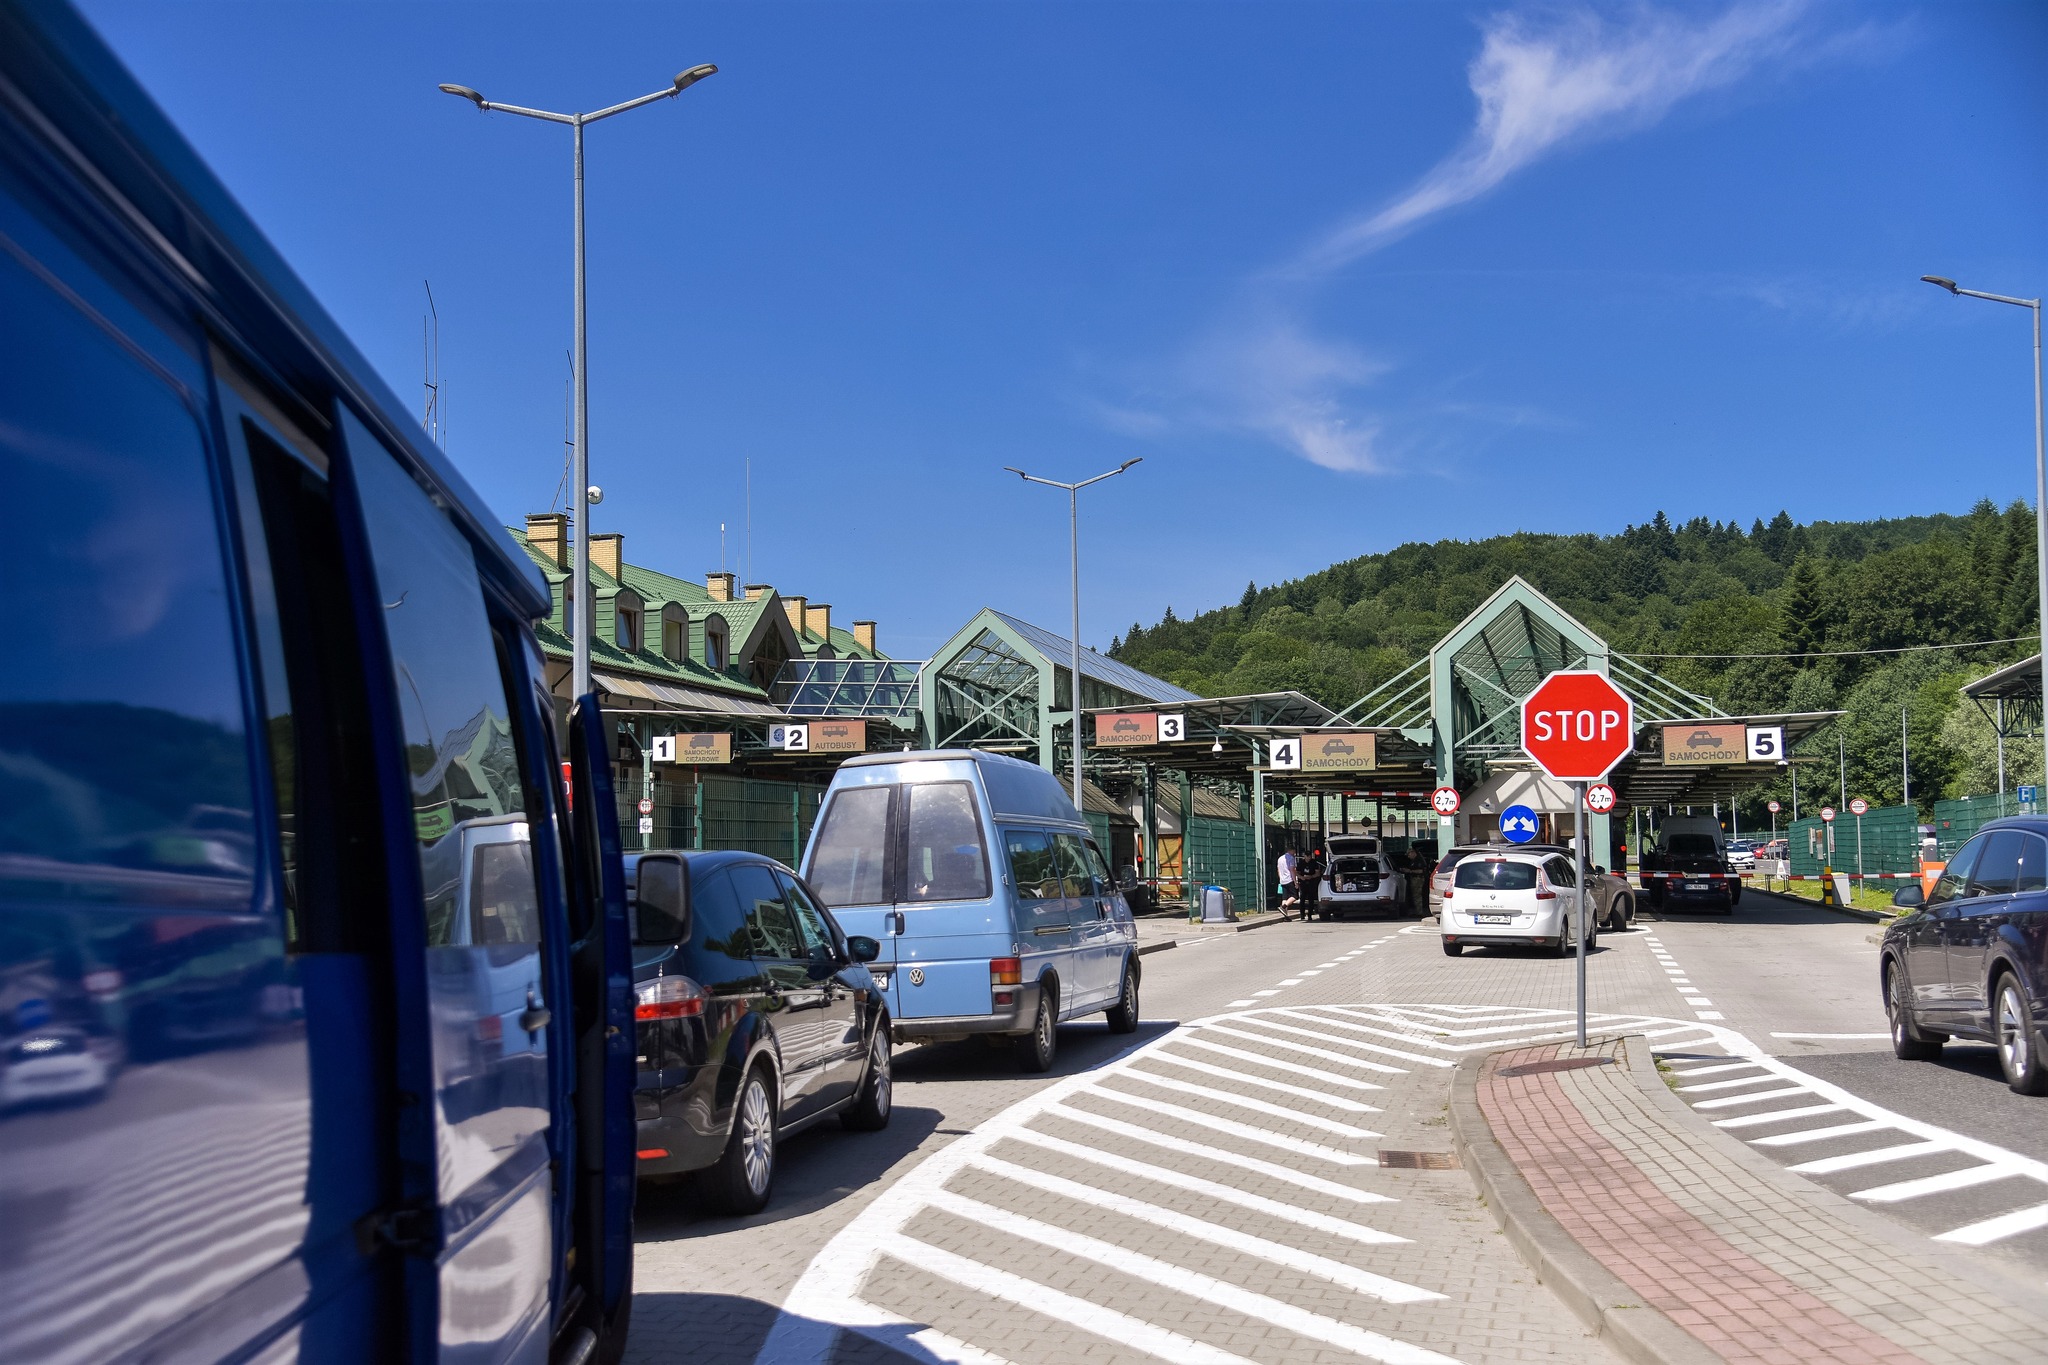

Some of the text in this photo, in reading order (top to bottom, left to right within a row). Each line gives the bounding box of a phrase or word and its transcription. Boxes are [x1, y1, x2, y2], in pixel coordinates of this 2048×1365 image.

[1164, 719, 1179, 737] 3
[1534, 710, 1620, 741] STOP
[789, 729, 803, 747] 2
[814, 741, 857, 750] AUTOBUSY
[1100, 734, 1153, 743] SAMOCHODY
[1755, 733, 1775, 755] 5
[658, 740, 667, 757] 1
[1275, 744, 1293, 765] 4
[1669, 751, 1740, 761] SAMOCHODY
[1306, 758, 1370, 767] SAMOCHODY
